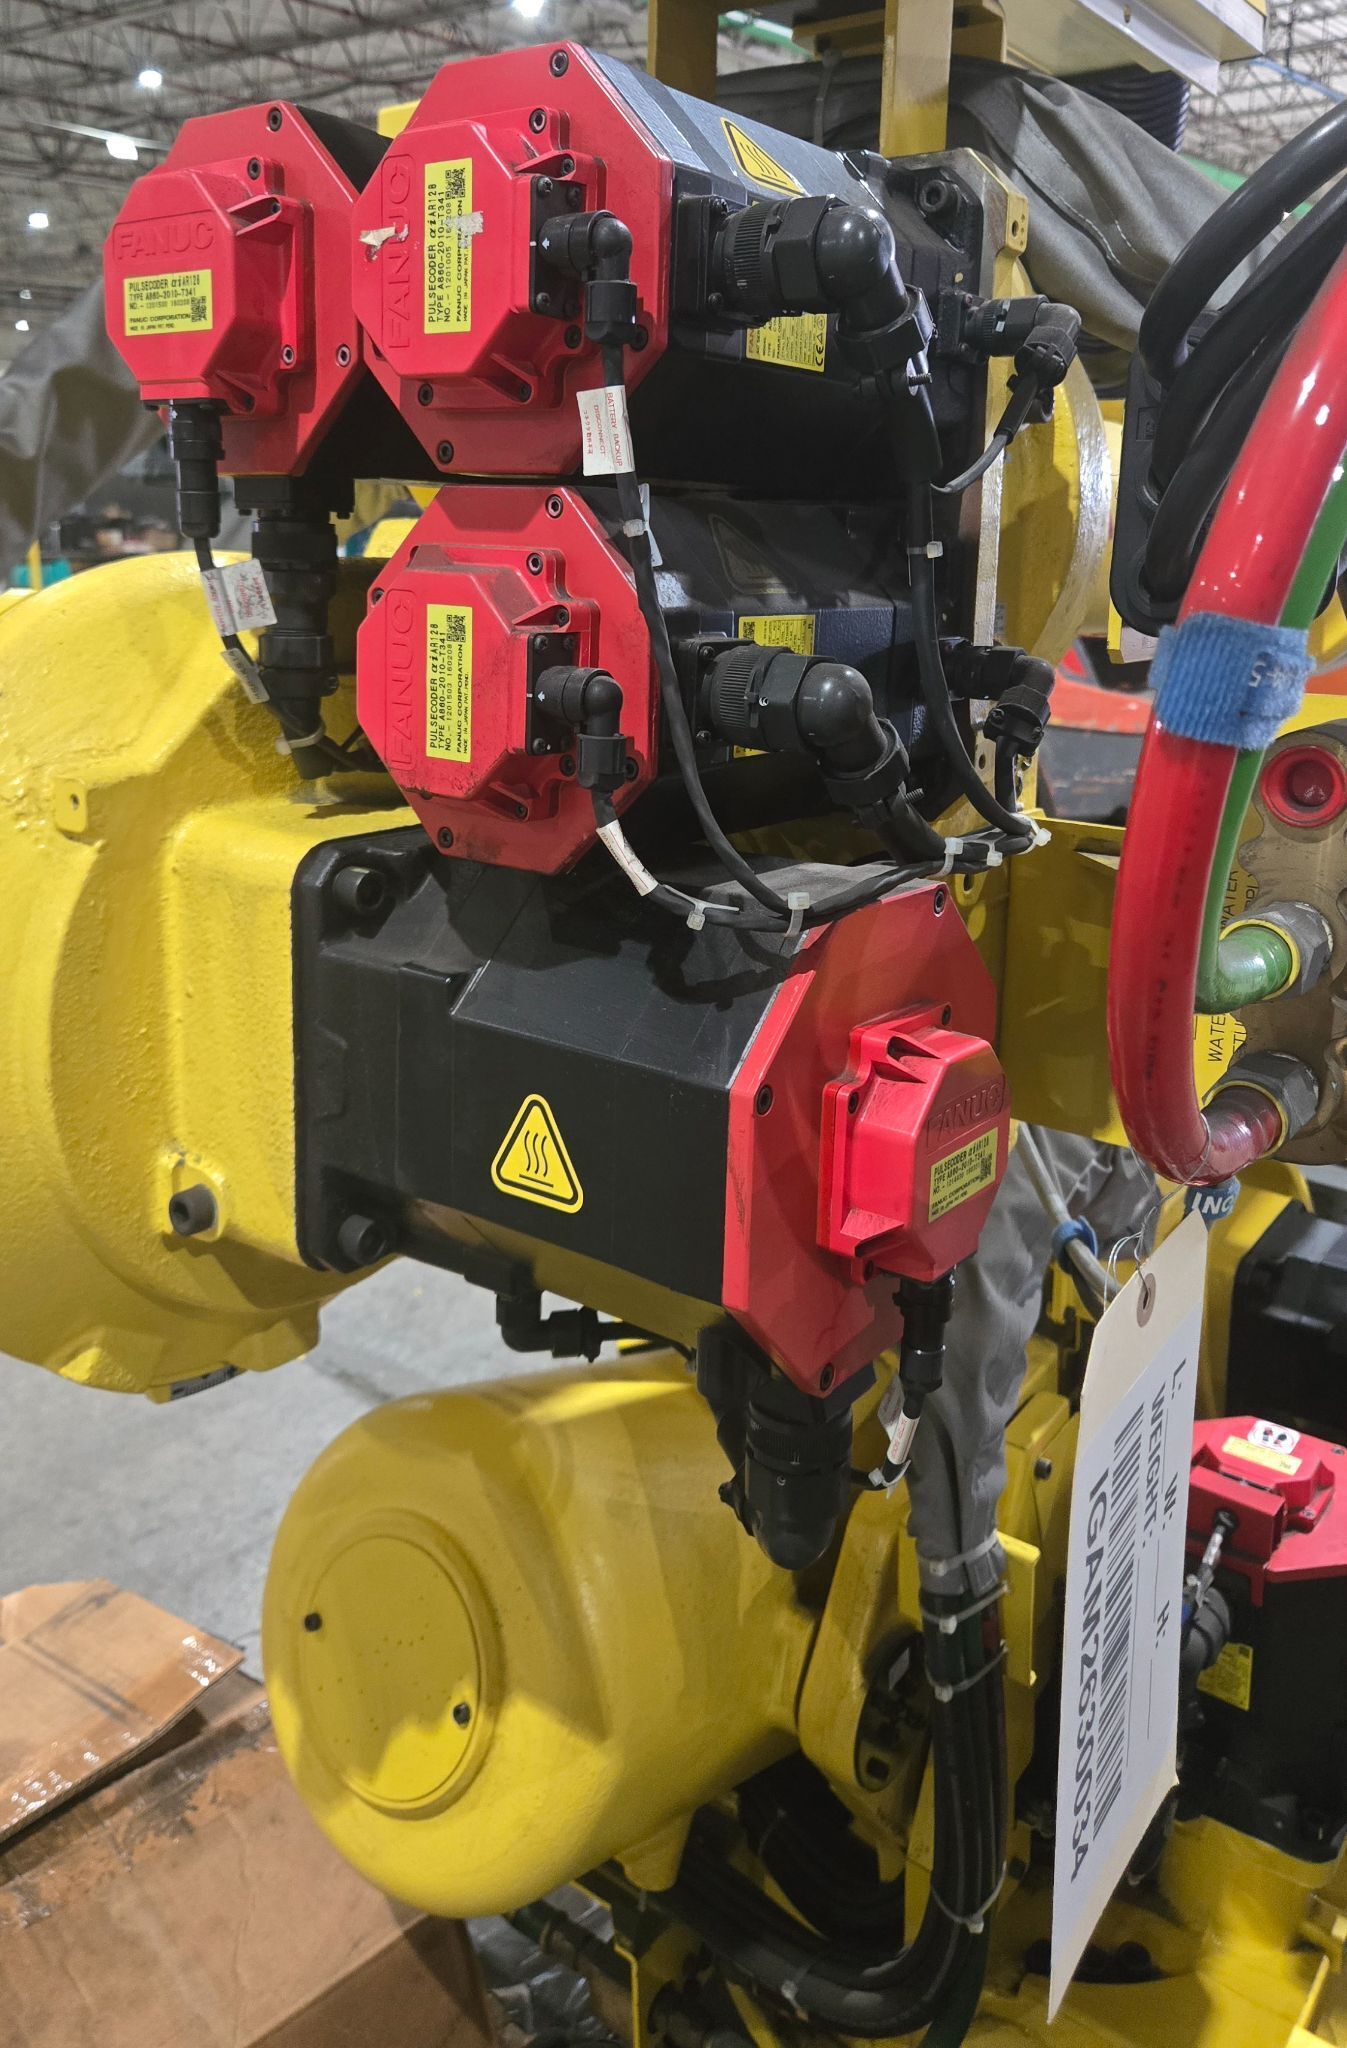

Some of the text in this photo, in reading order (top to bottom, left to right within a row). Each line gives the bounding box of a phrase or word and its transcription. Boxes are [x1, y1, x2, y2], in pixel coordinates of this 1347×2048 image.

[118, 222, 214, 260] FANUC
[387, 163, 410, 348] FANUC
[129, 278, 168, 292] PULSECODER
[129, 292, 143, 301] TYPE
[428, 244, 436, 323] PULSECODER
[594, 404, 606, 455] DISCONNECT
[607, 392, 623, 467] BATTERY BACKUP
[391, 600, 413, 764] FANUC
[430, 678, 438, 749] PULSECODER
[1207, 1014, 1226, 1062] WATE
[929, 1083, 999, 1147] FANUC
[933, 1172, 945, 1186] TYPE
[934, 1150, 967, 1175] PULSECODER
[1142, 1381, 1167, 1549] WEIGHT:
[1154, 1357, 1187, 1650] L: W: H:
[1070, 1467, 1110, 1883] IGAM2630034
